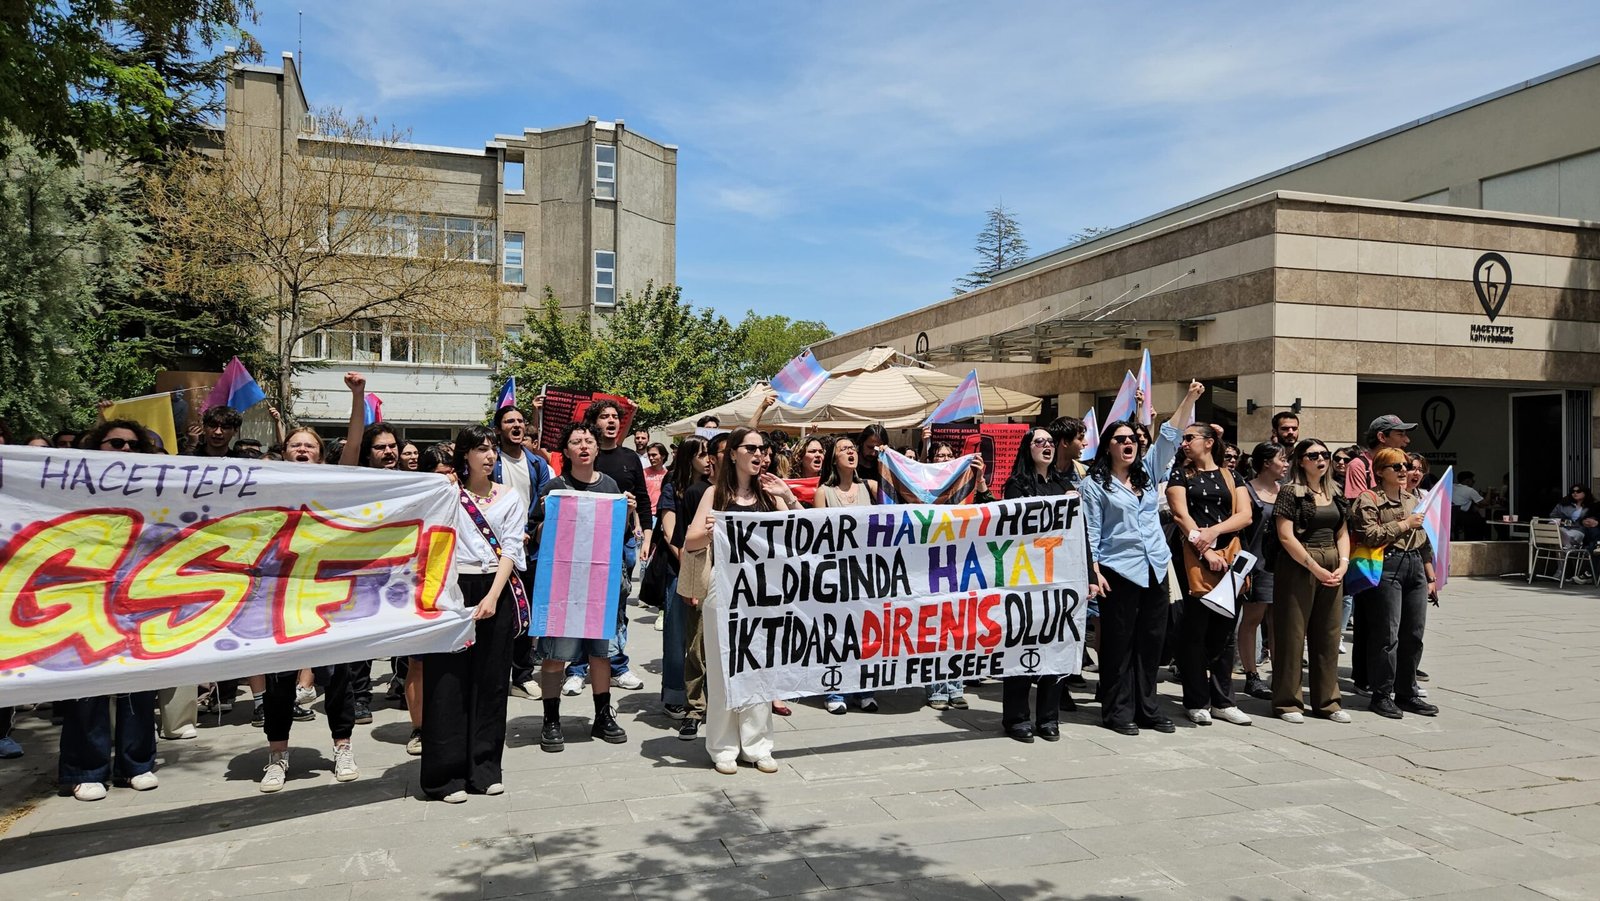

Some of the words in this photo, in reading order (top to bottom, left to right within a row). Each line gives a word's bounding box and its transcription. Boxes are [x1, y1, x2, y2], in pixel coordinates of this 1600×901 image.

[1470, 324, 1514, 335] HACETTEPE
[41, 456, 263, 497] HACETTEPE
[725, 514, 860, 563] İKTİDAR
[867, 507, 991, 547] HAYATI
[995, 498, 1080, 536] HEDEF
[729, 547, 912, 609] ALDIĞINDA
[928, 537, 1064, 593] HAYAT
[729, 611, 861, 678] İKTİDARA
[859, 591, 1001, 660] DİRENİŞ
[1004, 588, 1081, 649] OLUR
[859, 659, 898, 689] HÜ
[905, 652, 1004, 684] FELSEFE
